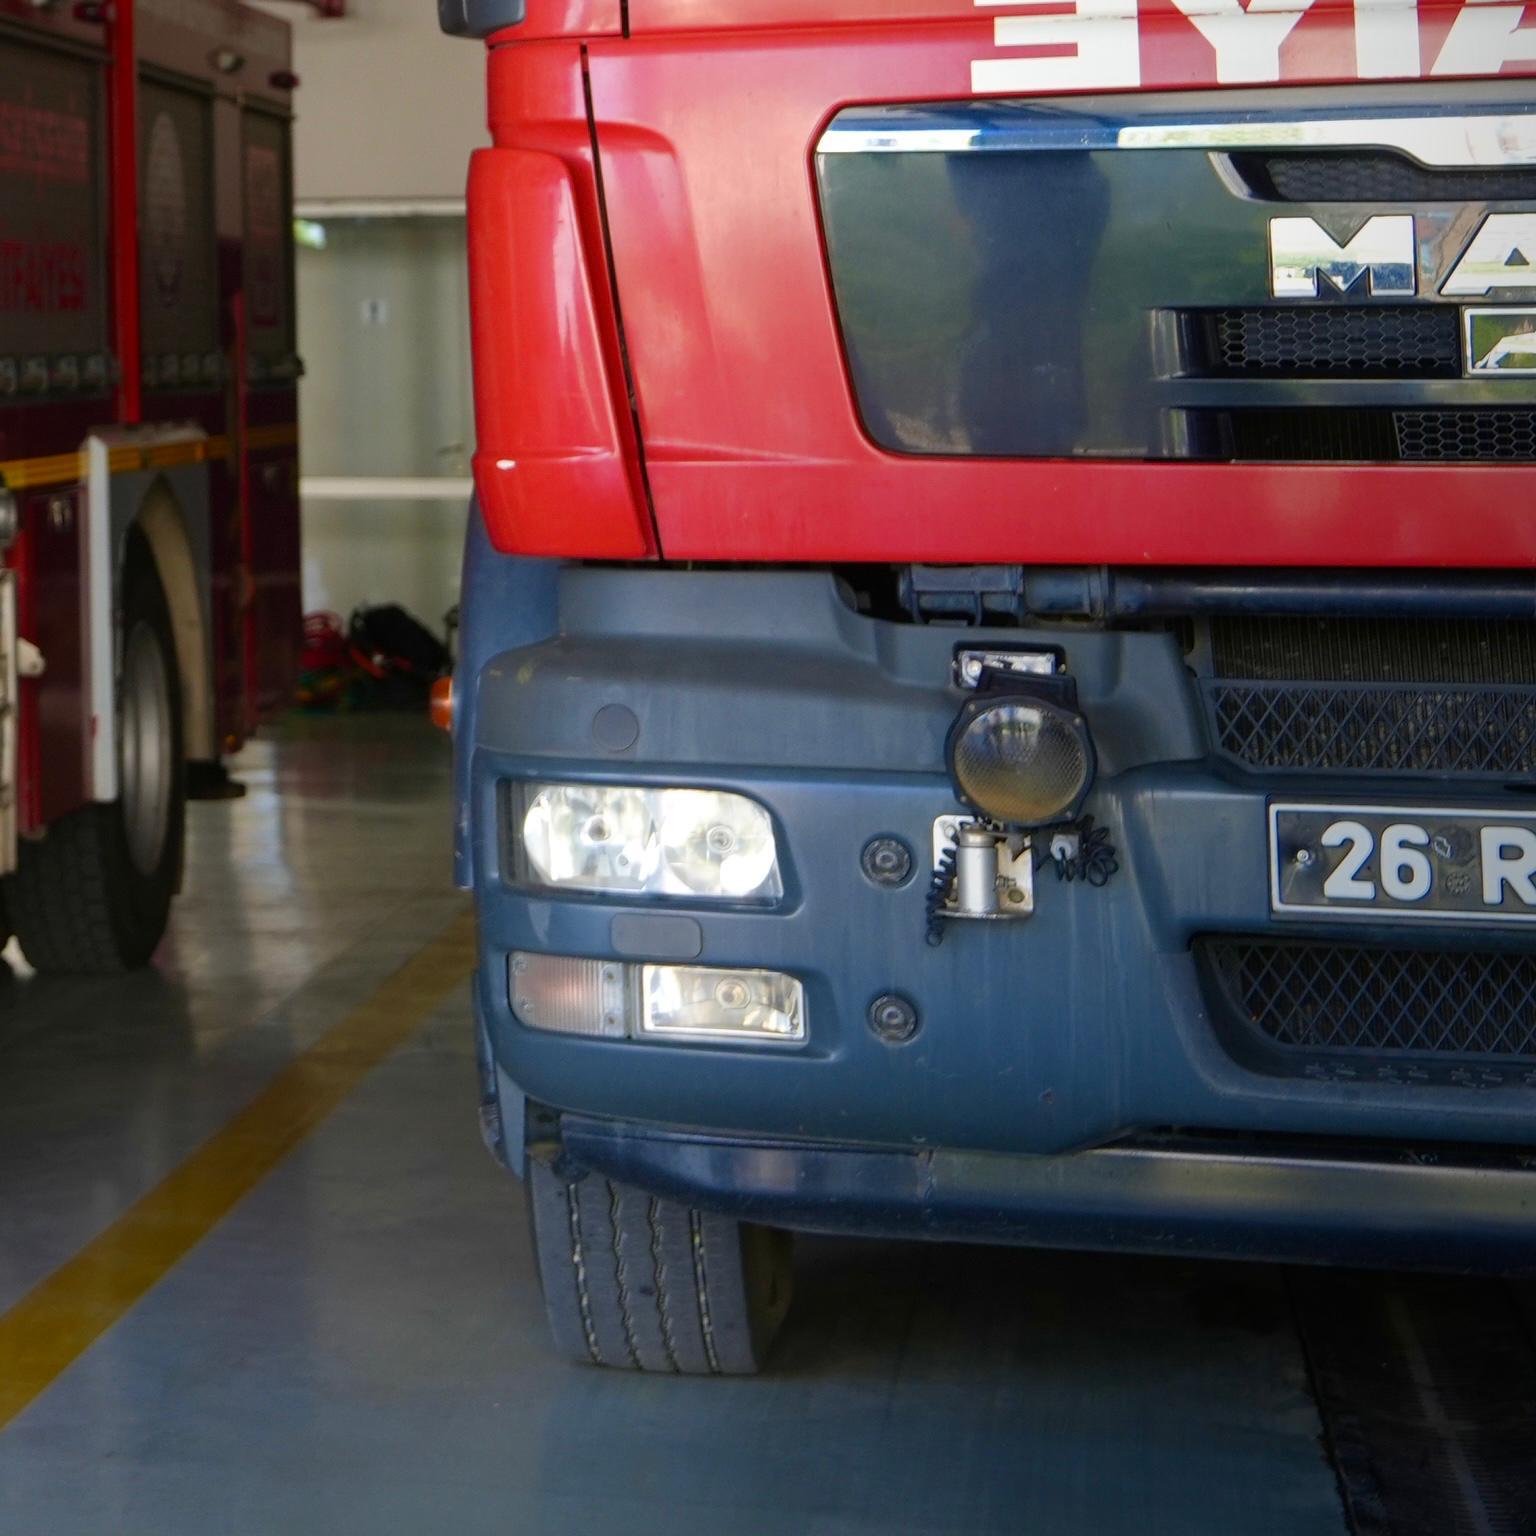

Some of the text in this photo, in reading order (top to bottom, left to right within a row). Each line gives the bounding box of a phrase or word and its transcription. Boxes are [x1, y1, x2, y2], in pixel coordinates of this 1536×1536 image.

[1269, 213, 1536, 297] MA
[1321, 821, 1536, 905] 26 R
